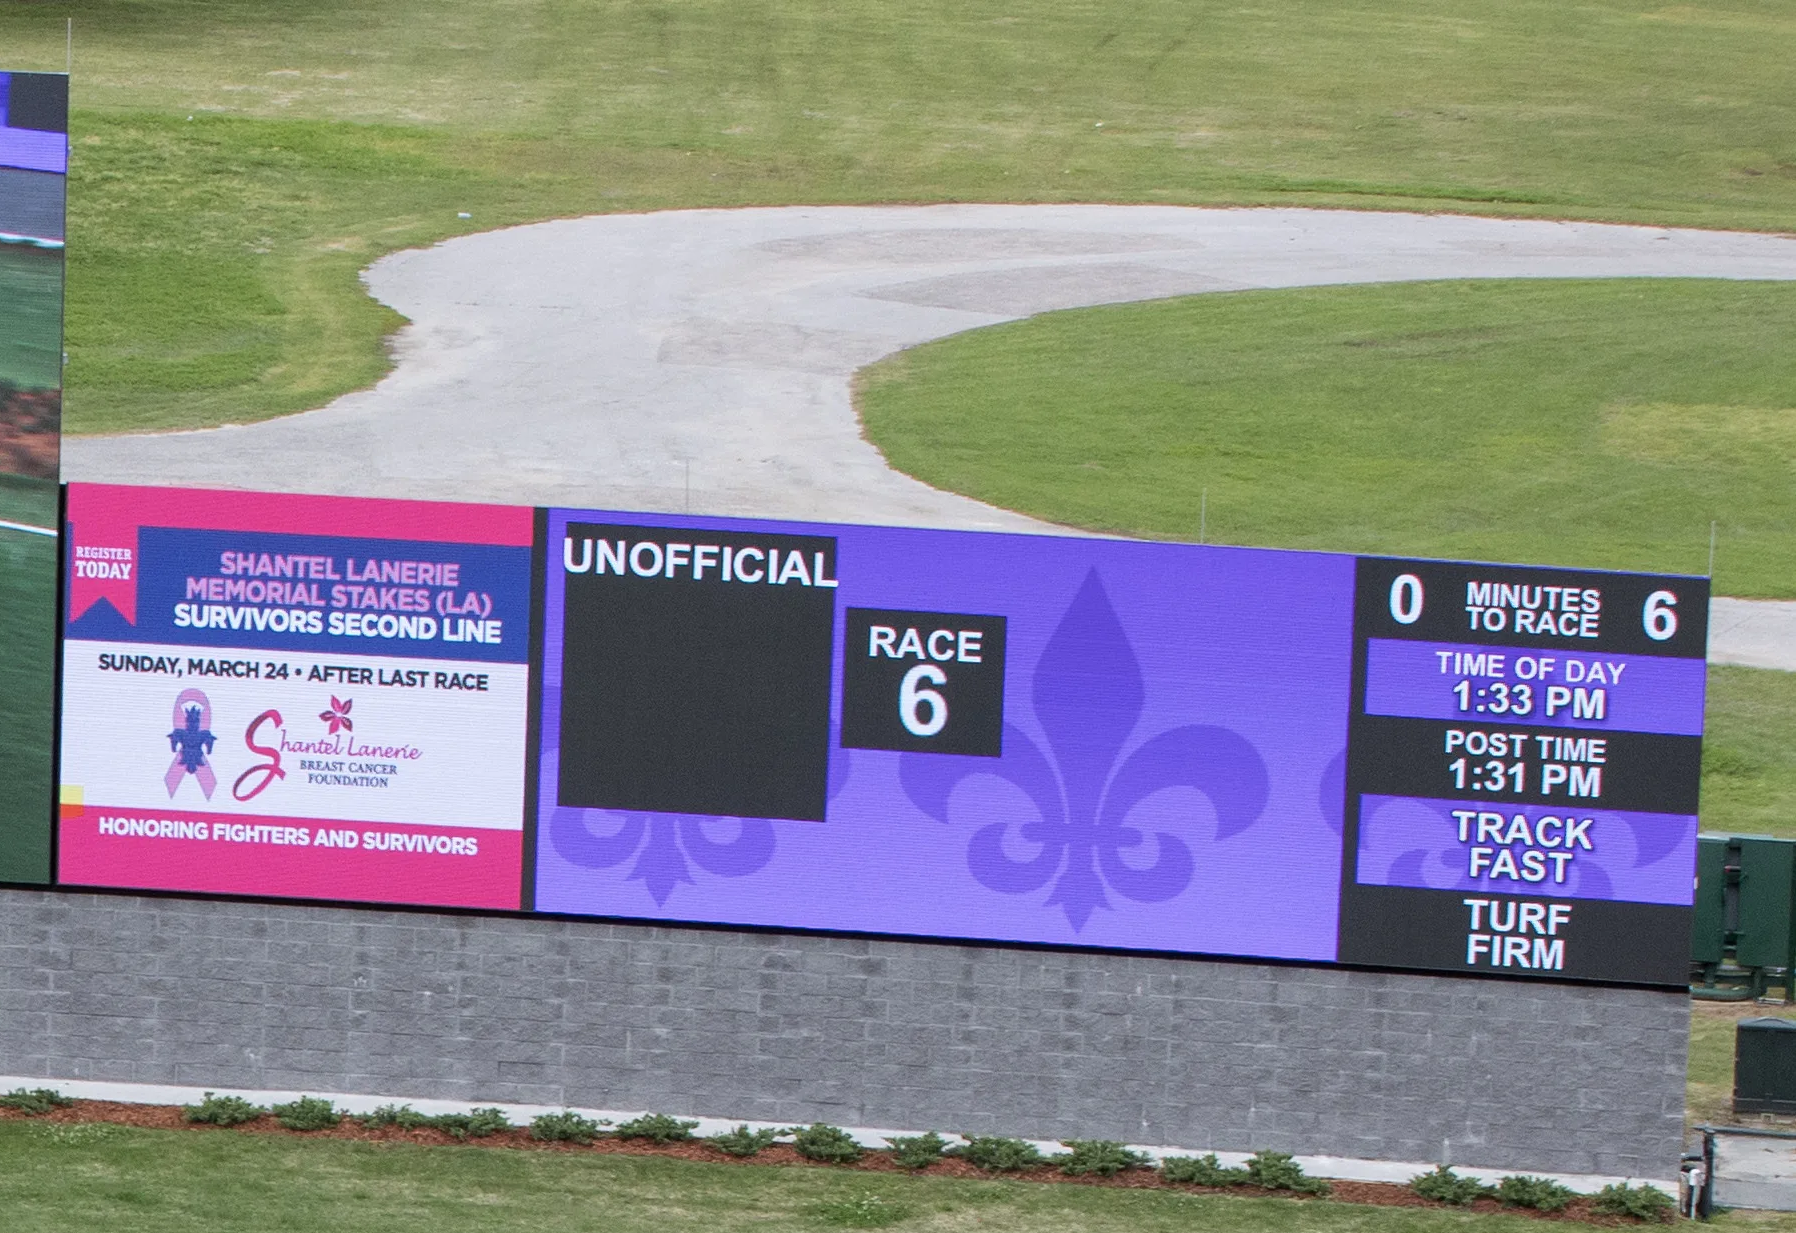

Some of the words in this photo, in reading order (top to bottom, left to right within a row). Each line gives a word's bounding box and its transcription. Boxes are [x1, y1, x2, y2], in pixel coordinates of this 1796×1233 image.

[75, 546, 132, 561] REGISTER
[75, 560, 132, 580] TODAY
[219, 551, 341, 581] SHANTEL
[346, 558, 460, 587] LANERIE
[563, 537, 840, 588] UNOFFICIAL
[185, 577, 326, 607] MEMORIAL
[330, 584, 430, 613] STAKES
[435, 590, 492, 620] (LA)
[1390, 574, 1423, 624] 0
[1466, 581, 1600, 612] MINUTES
[1644, 590, 1677, 640] 6
[173, 603, 324, 634] SURVIVORS
[327, 611, 438, 640] SECOND
[443, 617, 503, 644] LINE
[1465, 605, 1507, 632] TO
[1515, 609, 1600, 638] RACE
[869, 625, 983, 663] RACE
[98, 653, 183, 678] SUNDAY,
[187, 658, 260, 679] MARCH
[264, 662, 290, 681] 24
[307, 664, 374, 685] AFTER
[378, 668, 430, 688] LAST
[434, 671, 489, 692] RACE
[1435, 651, 1506, 678] TIME
[1514, 656, 1556, 681] OF
[1565, 659, 1626, 686] DAY
[900, 664, 948, 736] 6
[1453, 680, 1532, 715] 1:33
[1546, 686, 1605, 720] PM
[233, 709, 344, 801] Shantel
[348, 736, 423, 760] Lanerie
[1445, 729, 1528, 758] POST
[1535, 735, 1607, 763] TIME
[300, 760, 345, 772] BREAST
[348, 763, 397, 775] CANCER
[308, 773, 388, 787] FOUNDATION
[1449, 757, 1525, 793] 1:31
[1542, 763, 1601, 798] PM
[99, 816, 209, 840] HONORING
[212, 822, 311, 846] FIGHTERS
[313, 828, 359, 849] AND
[362, 831, 478, 856] SURVIVORS
[1451, 810, 1593, 850] TRACK
[1470, 847, 1573, 883] FAST
[1463, 898, 1572, 936] TURF
[1467, 933, 1565, 970] FIRM
